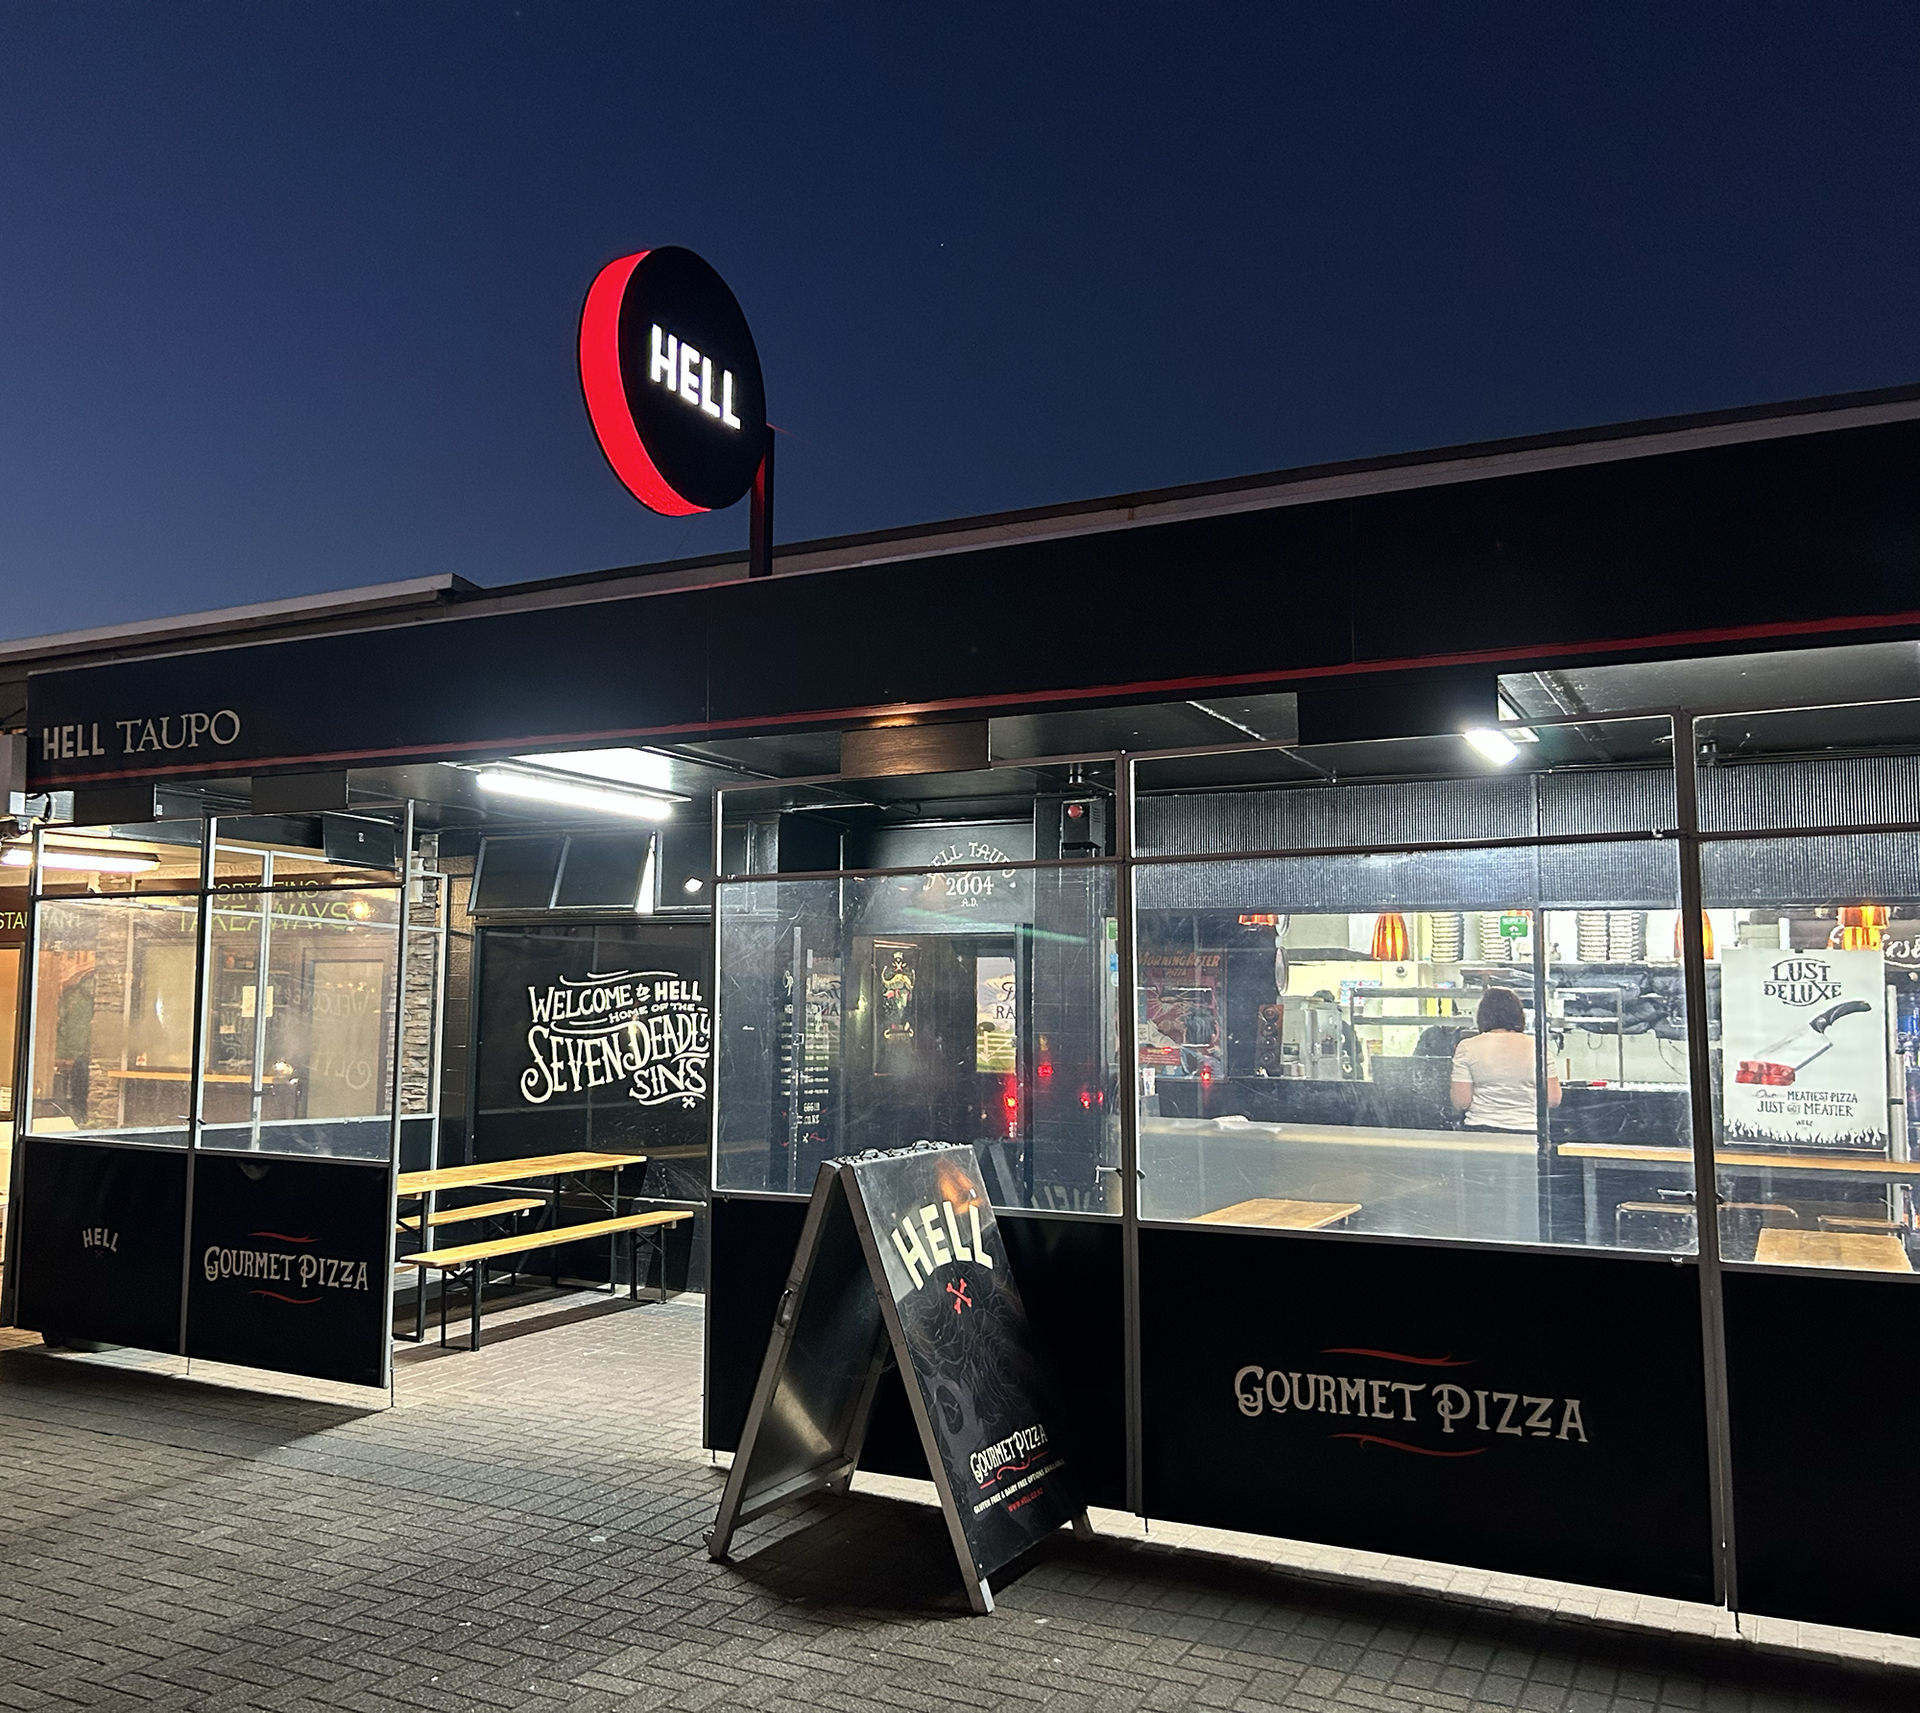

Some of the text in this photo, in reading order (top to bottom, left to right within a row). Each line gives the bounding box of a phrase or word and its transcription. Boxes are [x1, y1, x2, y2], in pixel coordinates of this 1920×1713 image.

[650, 323, 741, 430] HELL
[43, 709, 240, 760] HELL TAUPO
[968, 842, 1016, 878] TAUO
[946, 875, 994, 896] 2004
[1771, 959, 1831, 981] LUST
[528, 984, 634, 1023] WELCOME
[654, 981, 702, 1002] HELL
[609, 1002, 695, 1024] HOME OF THE
[1764, 981, 1842, 1004] DELUXE
[521, 1025, 627, 1104] SEVEN
[623, 1011, 710, 1071] DEADLY
[629, 1058, 707, 1100] SINS
[1787, 1091, 1829, 1102] MEATIEST
[1830, 1092, 1858, 1103] PIZZA
[1757, 1101, 1854, 1118] JUST GOT MEATIER
[82, 1227, 118, 1252] HELL
[891, 1201, 994, 1291] HELL
[204, 1246, 369, 1292] GOURMET PIZZA
[1234, 1365, 1589, 1443] GOURMET PIZZA
[970, 1424, 1048, 1484] GOURMET PIZZA
